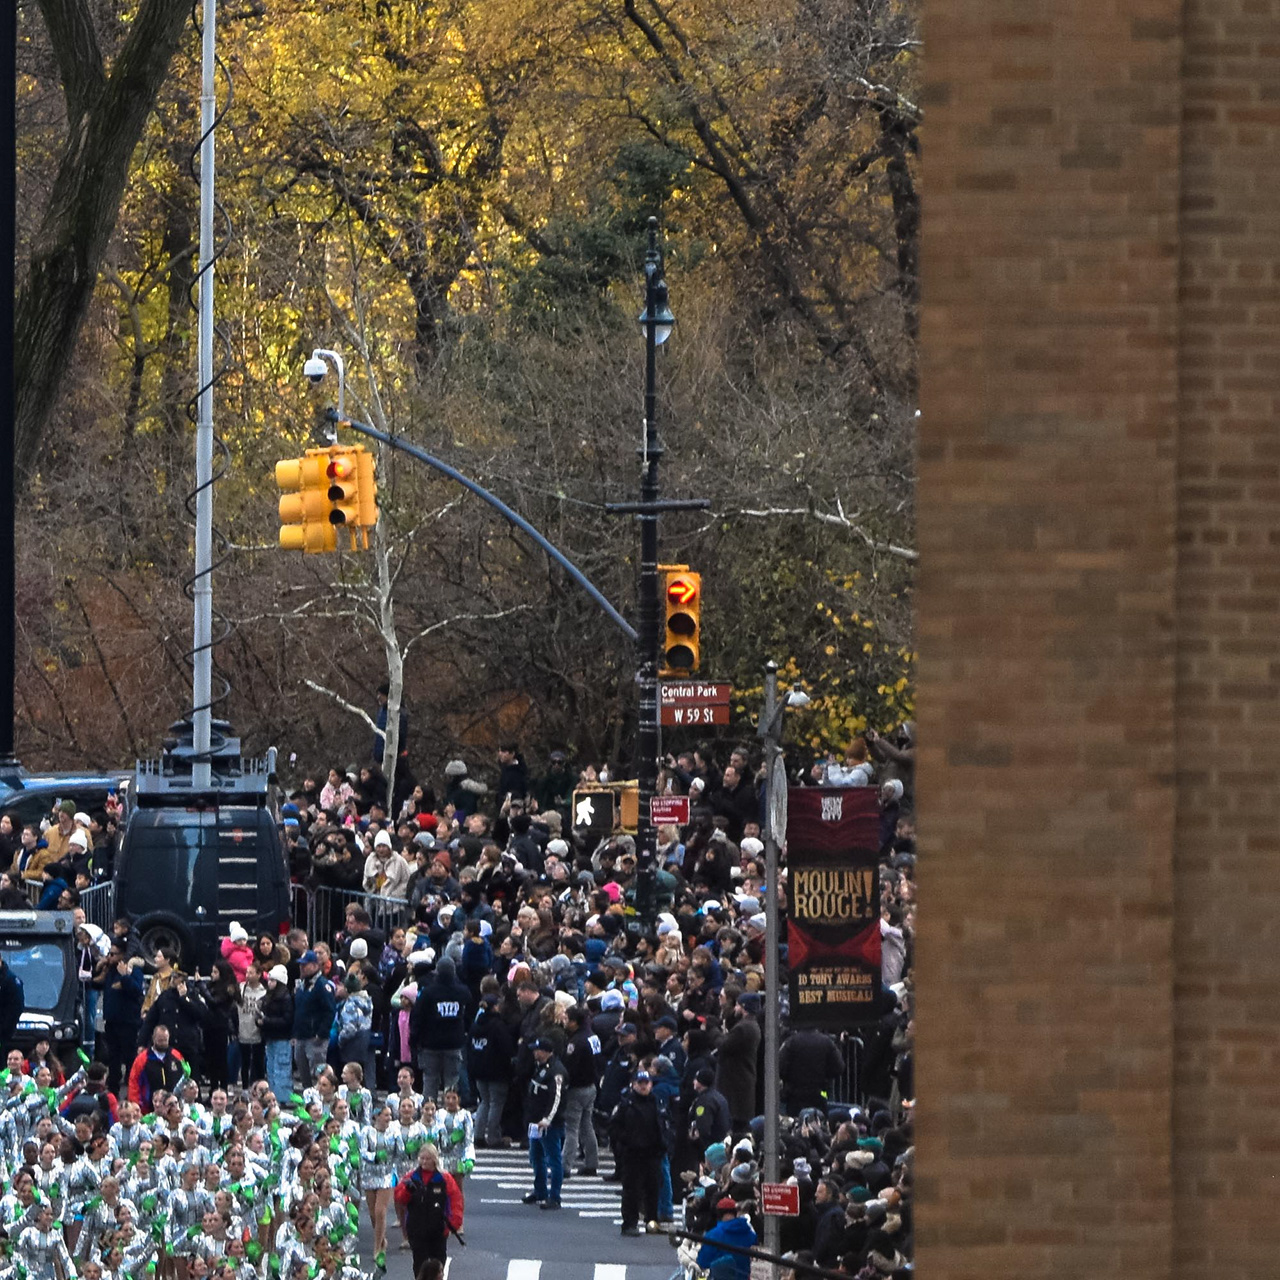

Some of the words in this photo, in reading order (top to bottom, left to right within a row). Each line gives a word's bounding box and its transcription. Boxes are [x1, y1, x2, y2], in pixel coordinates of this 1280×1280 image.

[662, 686, 694, 697] Central
[697, 686, 717, 697] Park
[674, 709, 683, 723] W
[687, 709, 700, 723] 59
[703, 708, 714, 723] St
[794, 870, 862, 897] MOULIN
[810, 973, 833, 985] TONY
[836, 973, 872, 984] AWARDS
[799, 990, 823, 1003] BEST
